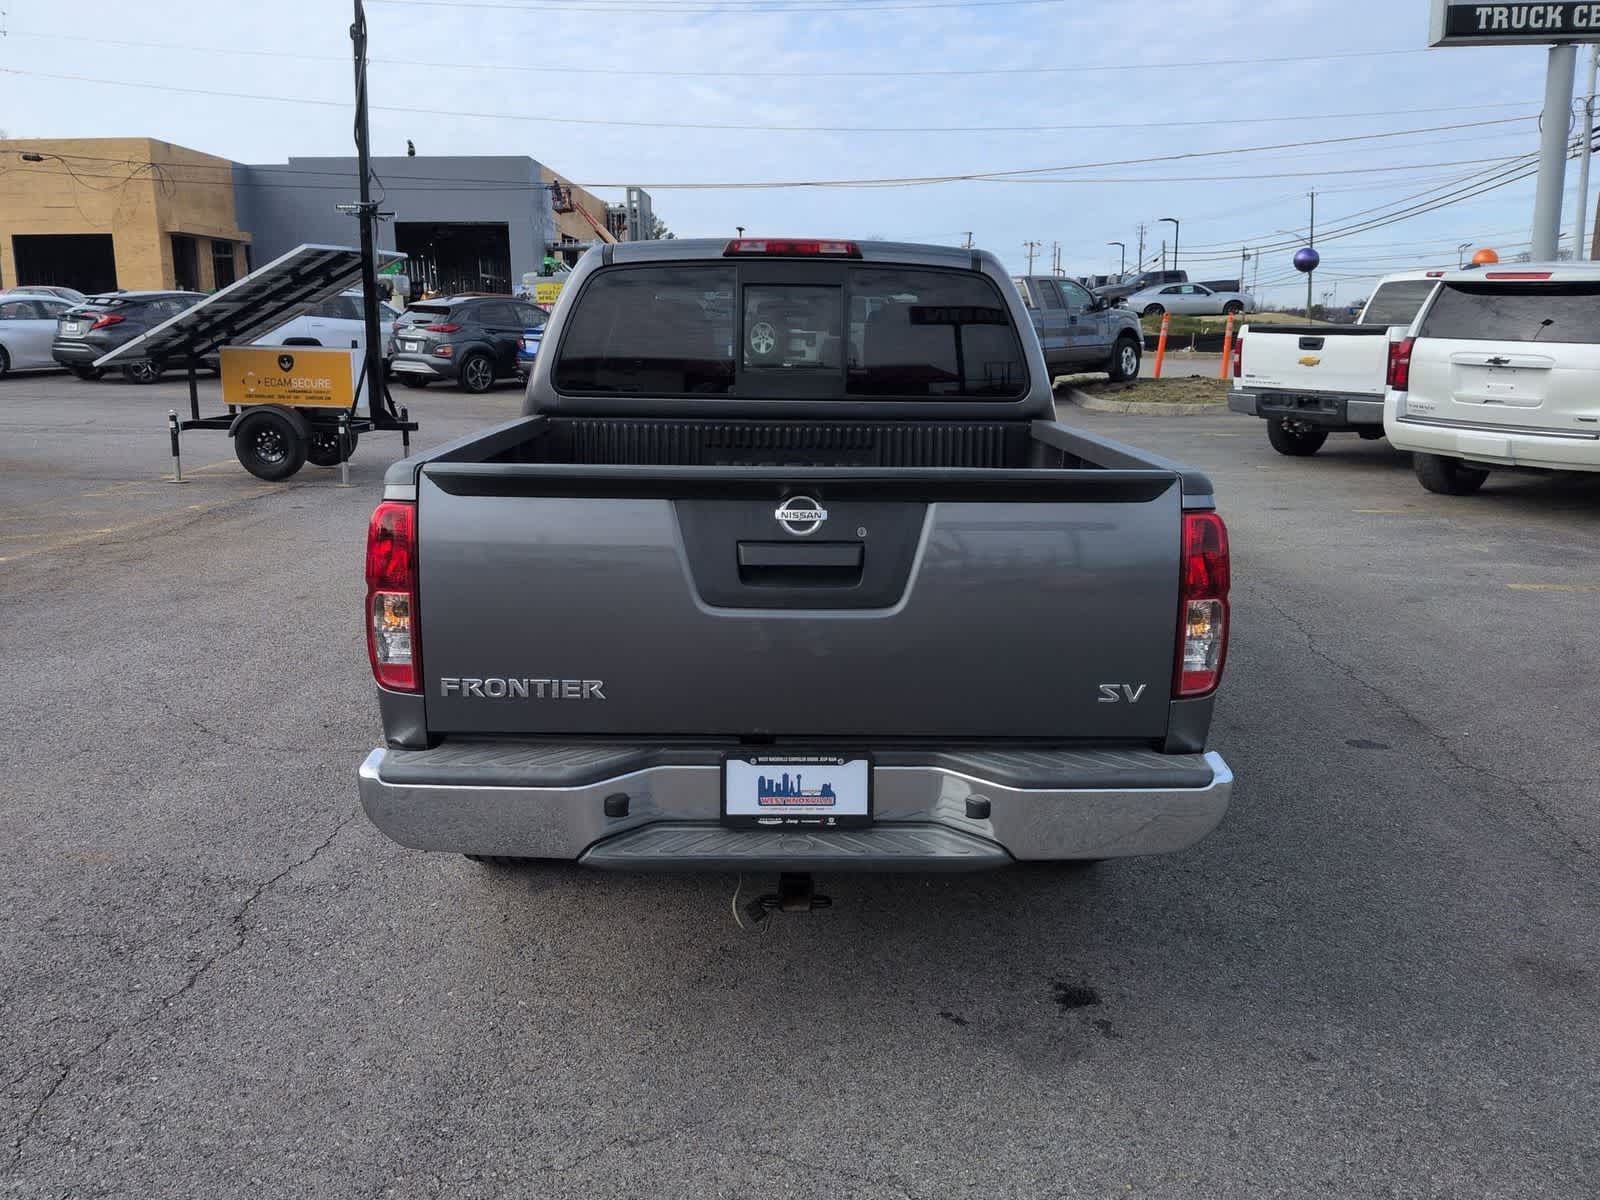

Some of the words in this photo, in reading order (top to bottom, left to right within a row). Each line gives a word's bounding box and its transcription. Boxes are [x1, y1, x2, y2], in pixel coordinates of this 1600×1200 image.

[1476, 5, 1562, 30] TRUCK
[264, 376, 332, 389] ECAMSECURE
[780, 510, 822, 519] NISSAN
[440, 677, 607, 700] FRONTIER
[1097, 683, 1147, 703] SV
